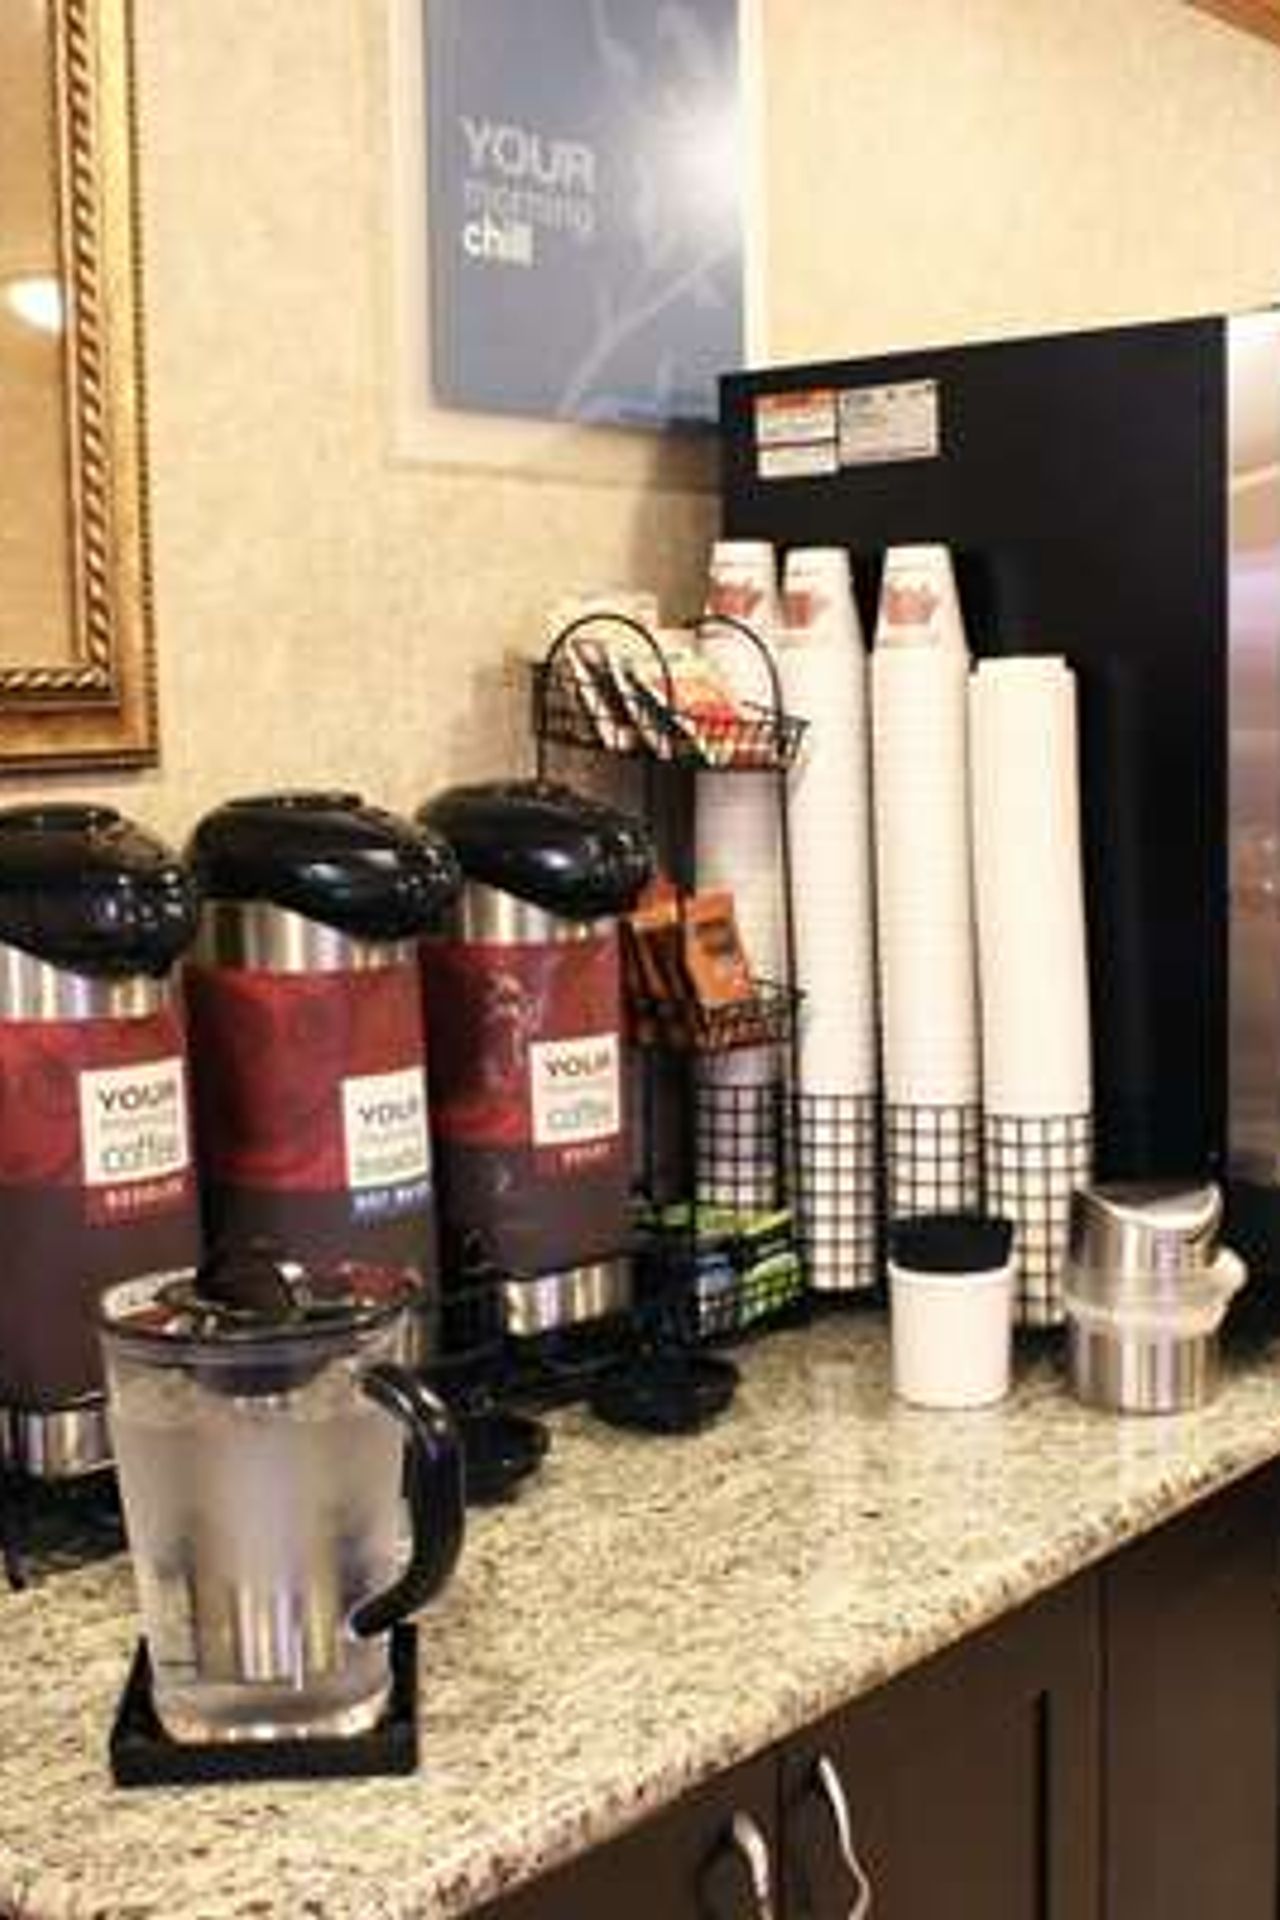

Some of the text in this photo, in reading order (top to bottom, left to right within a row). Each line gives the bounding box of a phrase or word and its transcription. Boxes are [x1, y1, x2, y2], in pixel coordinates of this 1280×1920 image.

[461, 115, 596, 194] YOUR
[463, 210, 534, 266] chill
[545, 1049, 611, 1078] YOUR
[97, 1079, 177, 1111] YOUR
